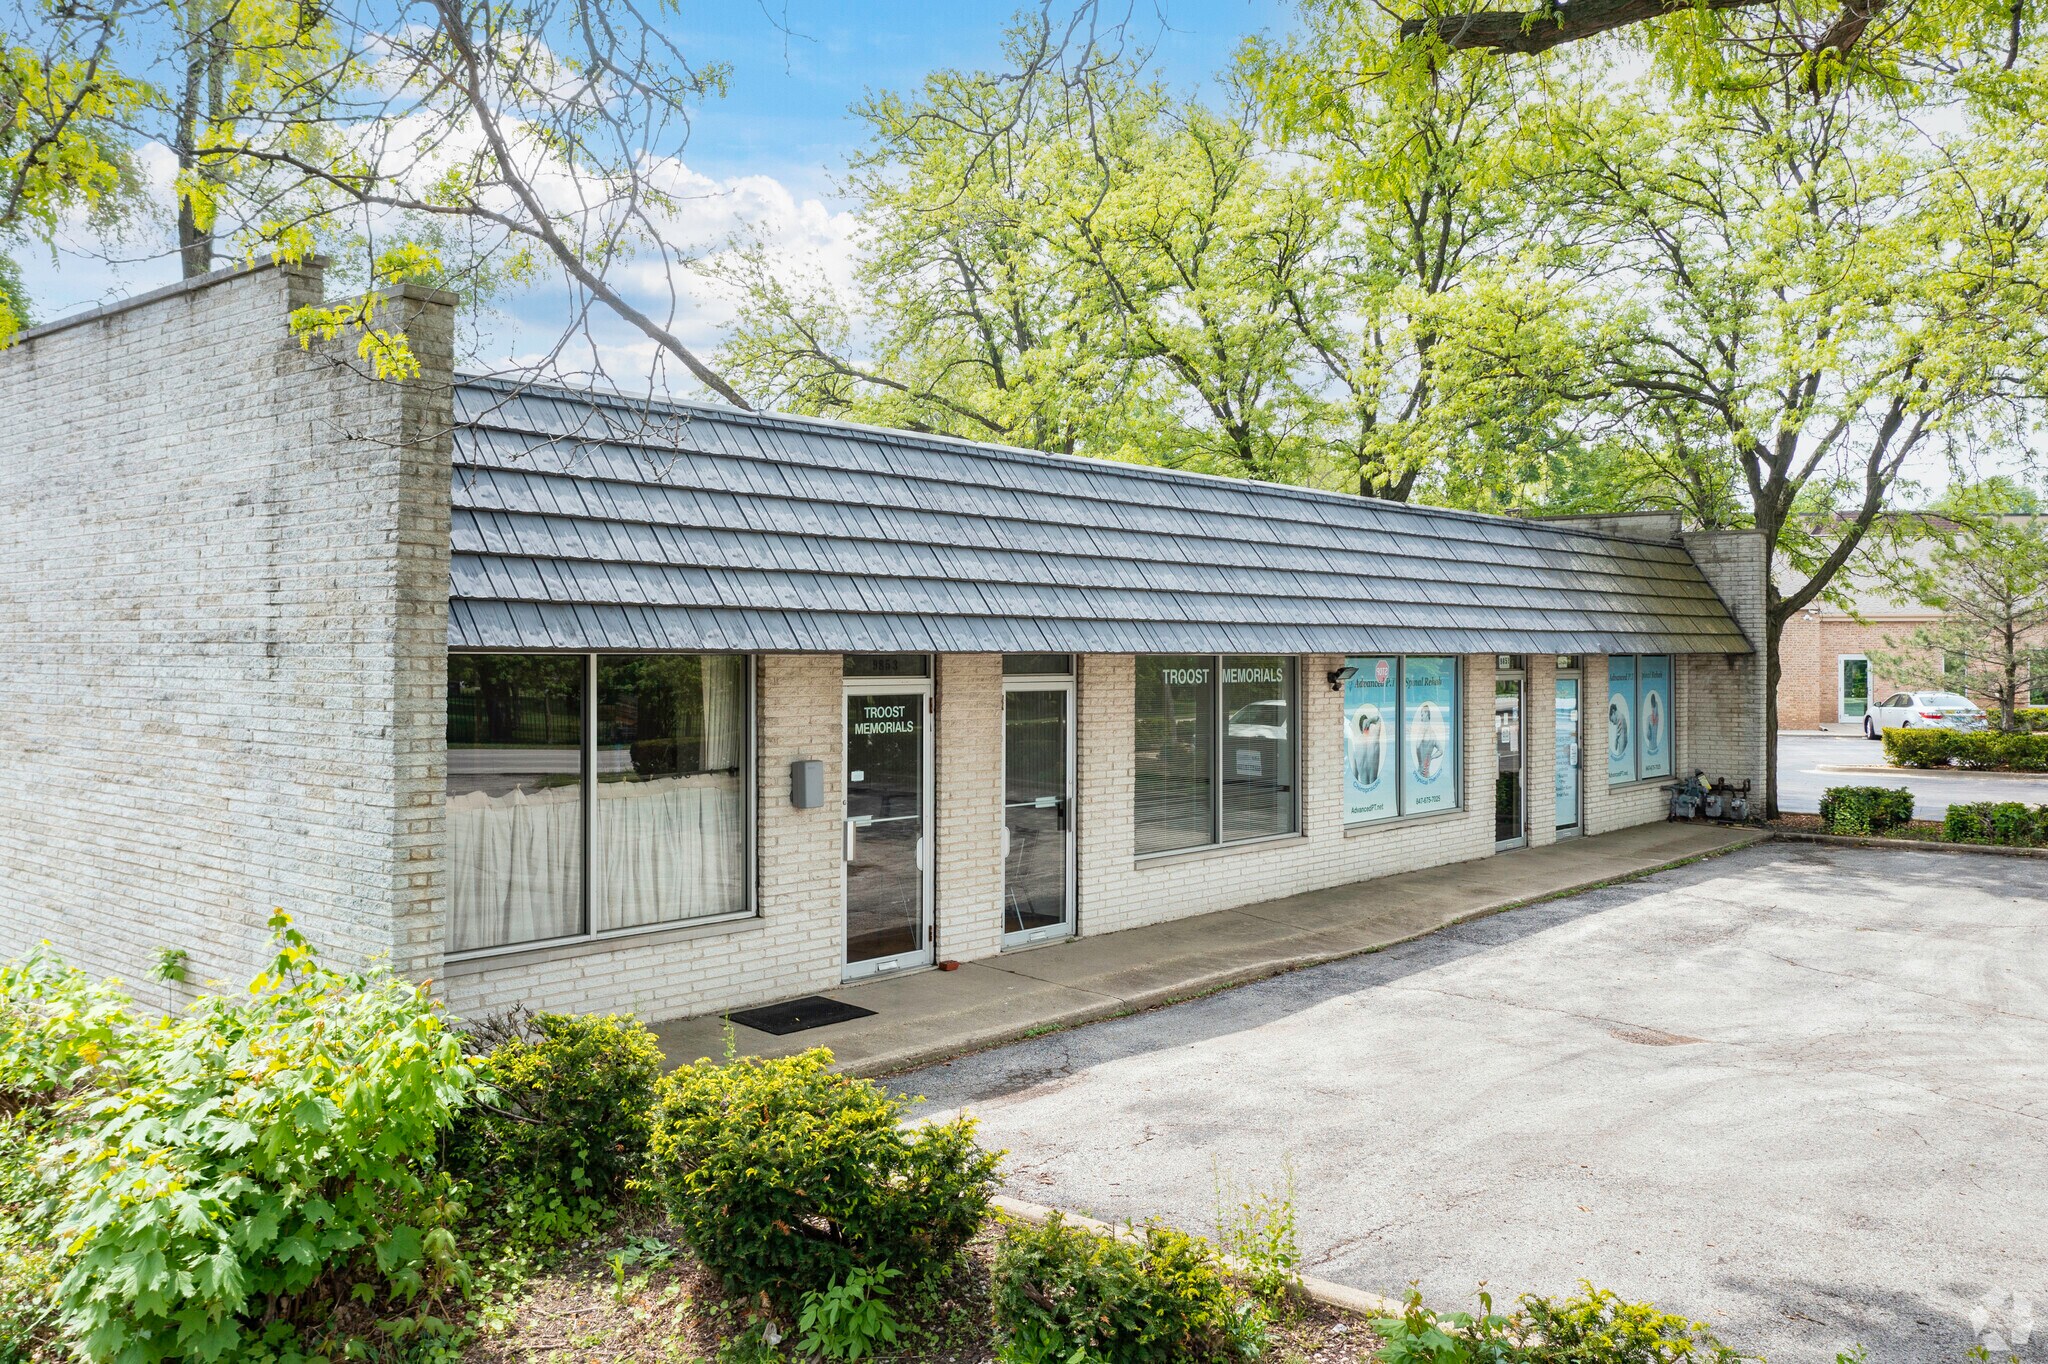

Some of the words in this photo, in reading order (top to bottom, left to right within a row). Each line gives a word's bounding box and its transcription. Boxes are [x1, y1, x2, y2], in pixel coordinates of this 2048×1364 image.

[1163, 668, 1209, 684] TROOST
[1222, 668, 1283, 683] MEMORIALS
[1354, 677, 1385, 688] Advanced
[1405, 677, 1424, 689] Spinal
[1424, 676, 1442, 686] Rehab
[864, 706, 905, 718] TROOST
[855, 720, 914, 735] MEMORIALS
